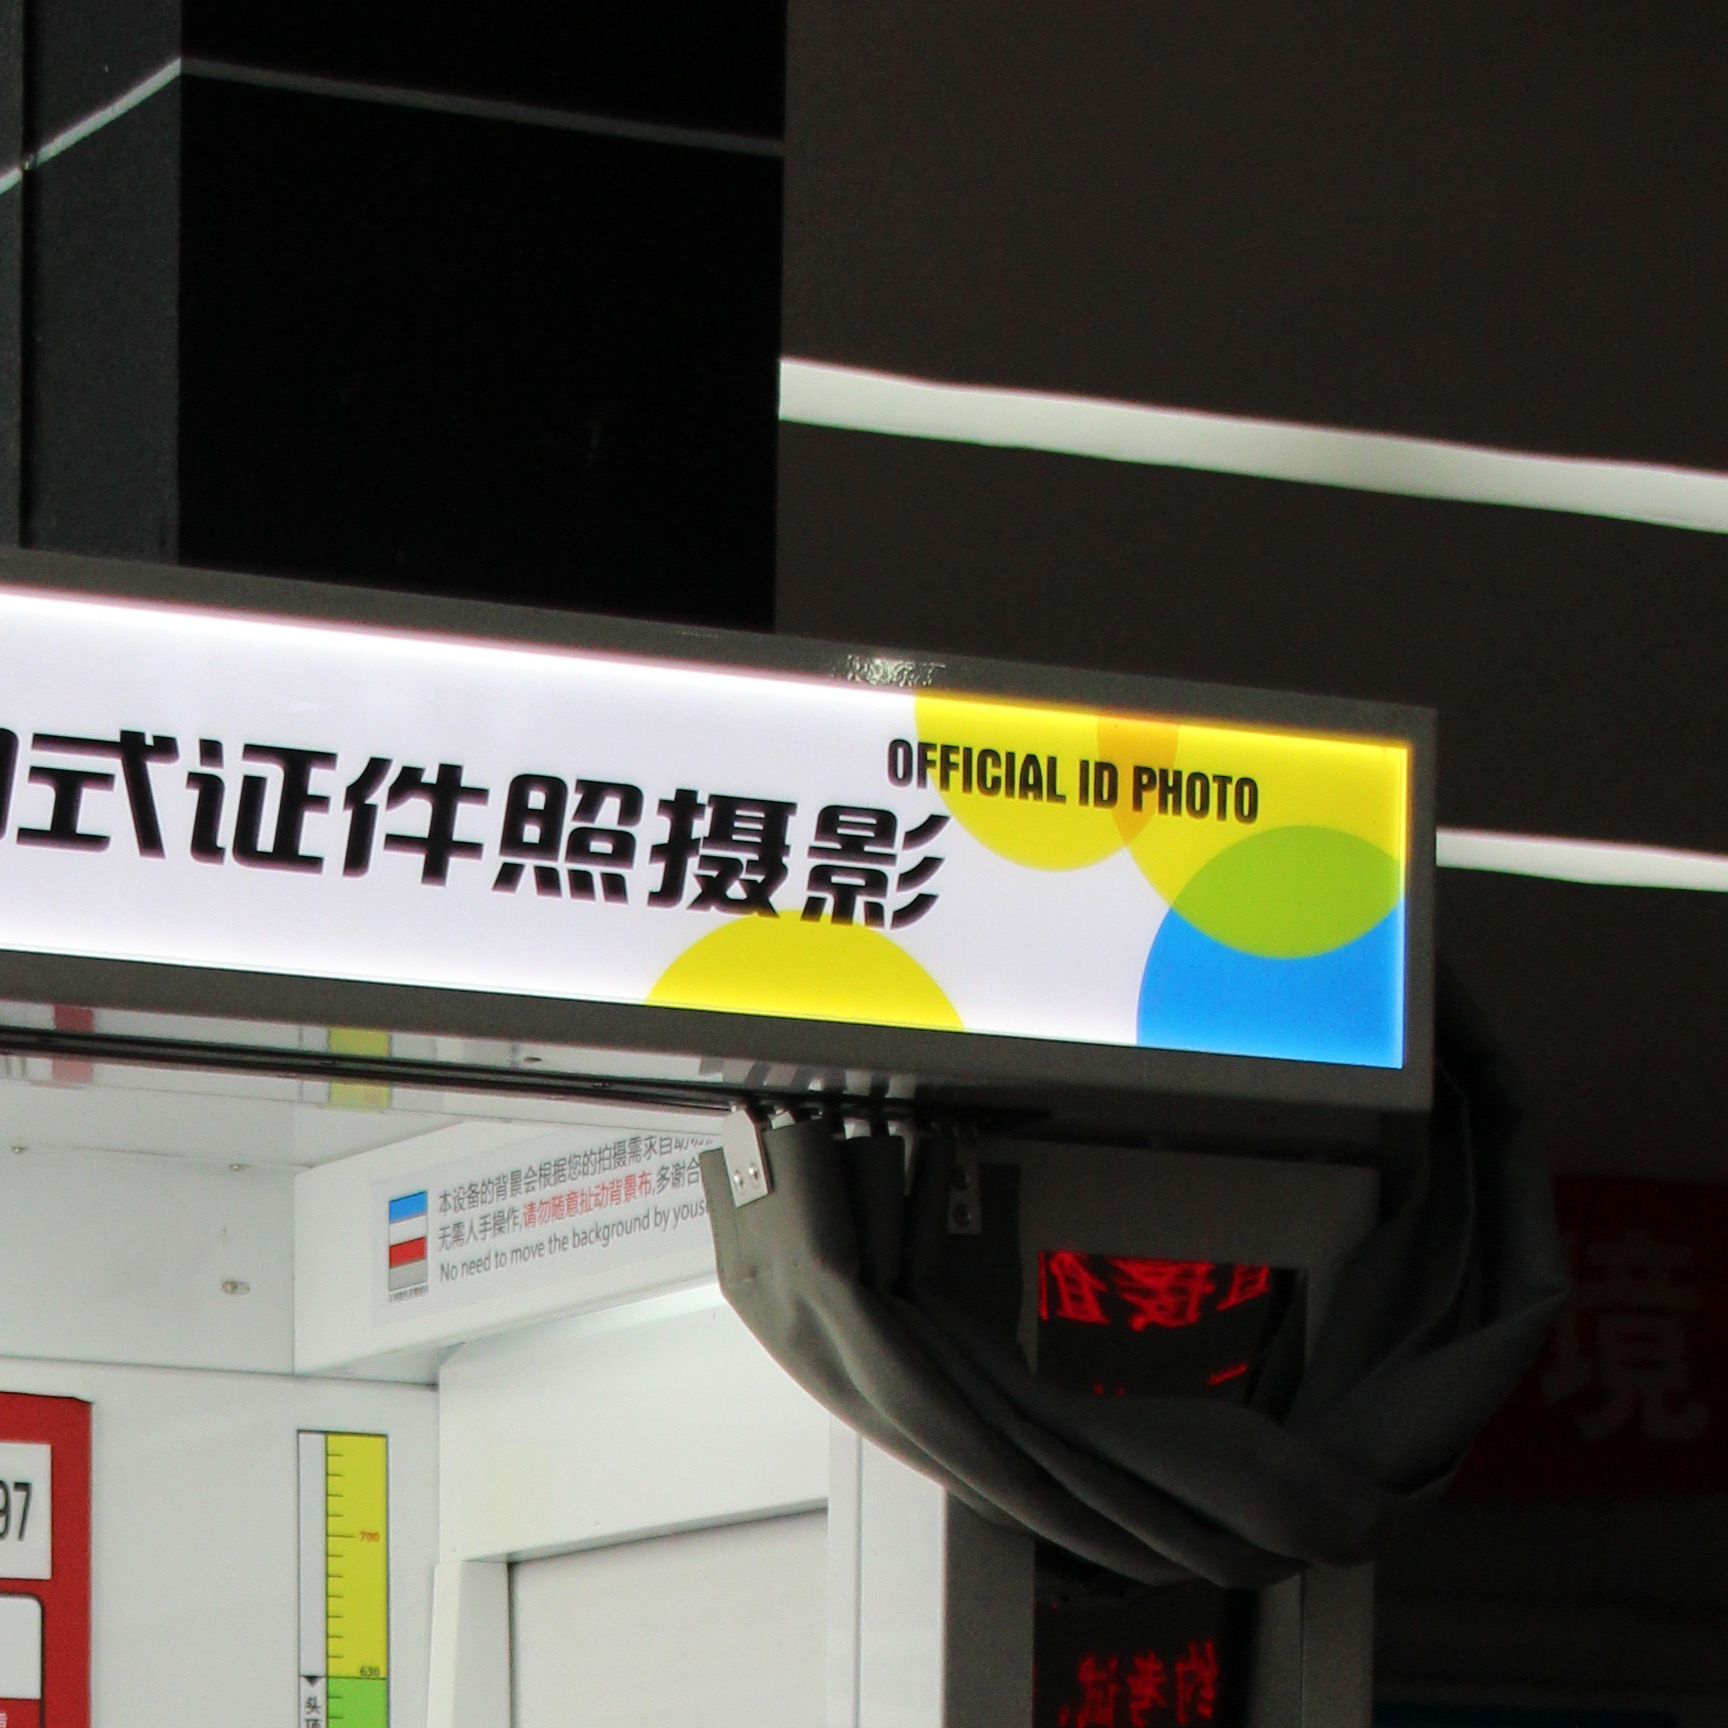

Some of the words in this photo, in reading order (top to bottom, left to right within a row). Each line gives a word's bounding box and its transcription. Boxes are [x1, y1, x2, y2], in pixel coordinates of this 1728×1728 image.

[886, 738, 1065, 808] OFFICIAL
[1076, 757, 1120, 812] ID
[1130, 762, 1261, 827] PHOTO
[439, 1261, 459, 1283] No
[461, 1253, 491, 1279] need
[494, 1251, 507, 1270] to
[510, 1244, 545, 1266] move
[548, 1234, 569, 1255] the
[572, 1211, 651, 1251] background
[653, 1206, 671, 1233] by
[672, 1198, 709, 1229] yous
